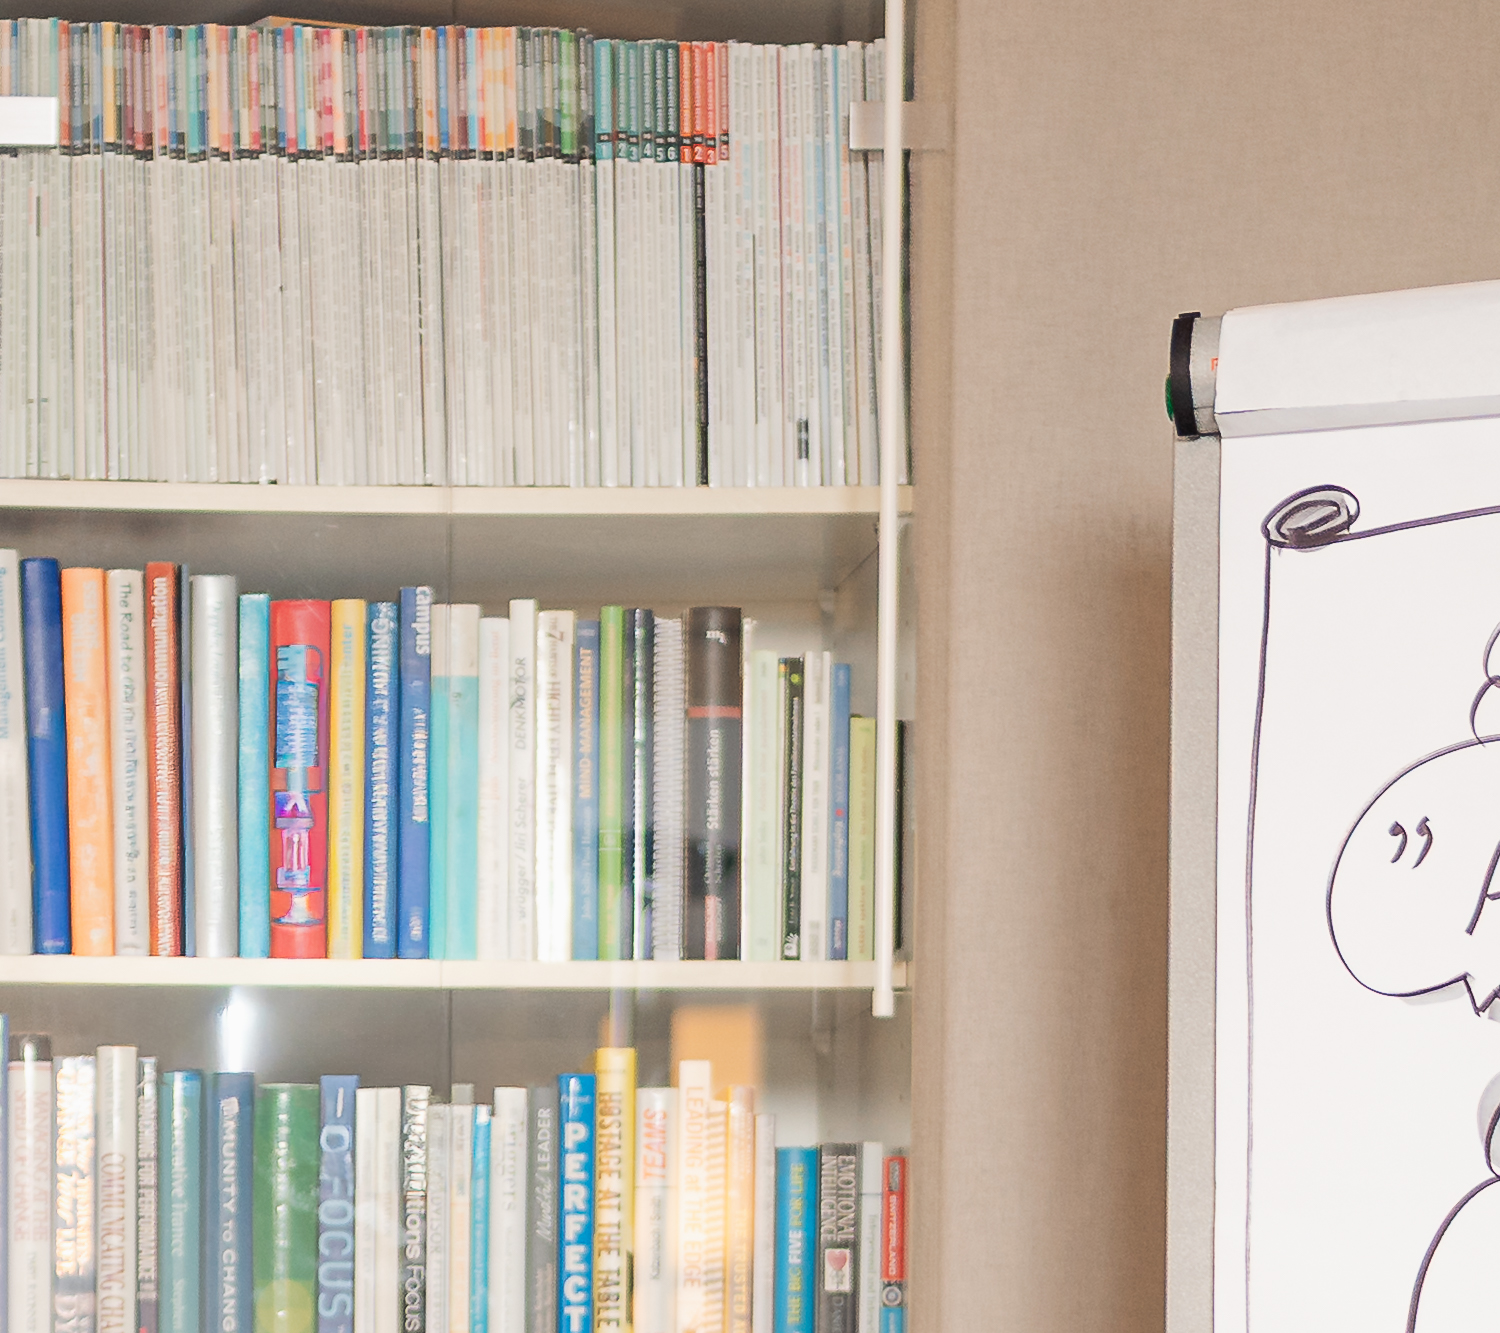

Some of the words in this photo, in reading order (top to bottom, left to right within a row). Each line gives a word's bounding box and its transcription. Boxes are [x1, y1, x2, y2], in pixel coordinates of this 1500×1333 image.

[120, 583, 133, 609] The
[411, 586, 433, 655] campus
[119, 612, 134, 649] Road
[546, 629, 564, 642] 7
[122, 656, 134, 672] to
[513, 657, 527, 750] DENKMOTOR
[546, 680, 563, 735] HIGHLY
[578, 647, 593, 799] MIND-MANAGEMENT
[706, 729, 721, 777] stärken
[513, 775, 527, 829] Scherer
[706, 781, 721, 830] Stärken
[514, 832, 527, 853] Jiri
[14, 1140, 30, 1162] OF
[33, 1090, 49, 1182] MANAGING
[537, 1108, 551, 1172] LEADER
[596, 1091, 622, 1180] HOSTAGE
[643, 1107, 668, 1180] TEAMS
[684, 1086, 705, 1168] LEADING
[139, 1161, 156, 1185] FOR
[496, 1118, 525, 1212] Triggers
[684, 1175, 702, 1193] at
[789, 1163, 804, 1195] LIFE
[14, 1165, 30, 1242] CHANGE
[34, 1185, 49, 1204] AT
[534, 1169, 554, 1242] Mindful
[597, 1188, 621, 1212] AT
[684, 1200, 702, 1234] THE
[789, 1197, 803, 1228] FOR
[821, 1154, 838, 1242] INTELLIGENCE
[837, 1154, 857, 1242] EMOTIONAL
[34, 1205, 49, 1243] THE
[100, 1152, 126, 1292] COMMUNICATING
[139, 1189, 156, 1281] PERFORMANCE
[171, 1201, 188, 1257] Trance
[562, 1121, 588, 1333] PERFECT
[597, 1220, 621, 1259] THE
[734, 1208, 748, 1238] THE
[788, 1230, 803, 1265] FIVE
[887, 1193, 898, 1276] SWITZERLAND
[56, 1227, 75, 1279] LIFE
[682, 1240, 702, 1288] EDGE
[733, 1242, 748, 1313] TRUSTED
[404, 1264, 424, 1331] Focus
[597, 1266, 621, 1329] TABLE
[787, 1267, 802, 1293] BIG
[787, 1294, 801, 1325] THE
